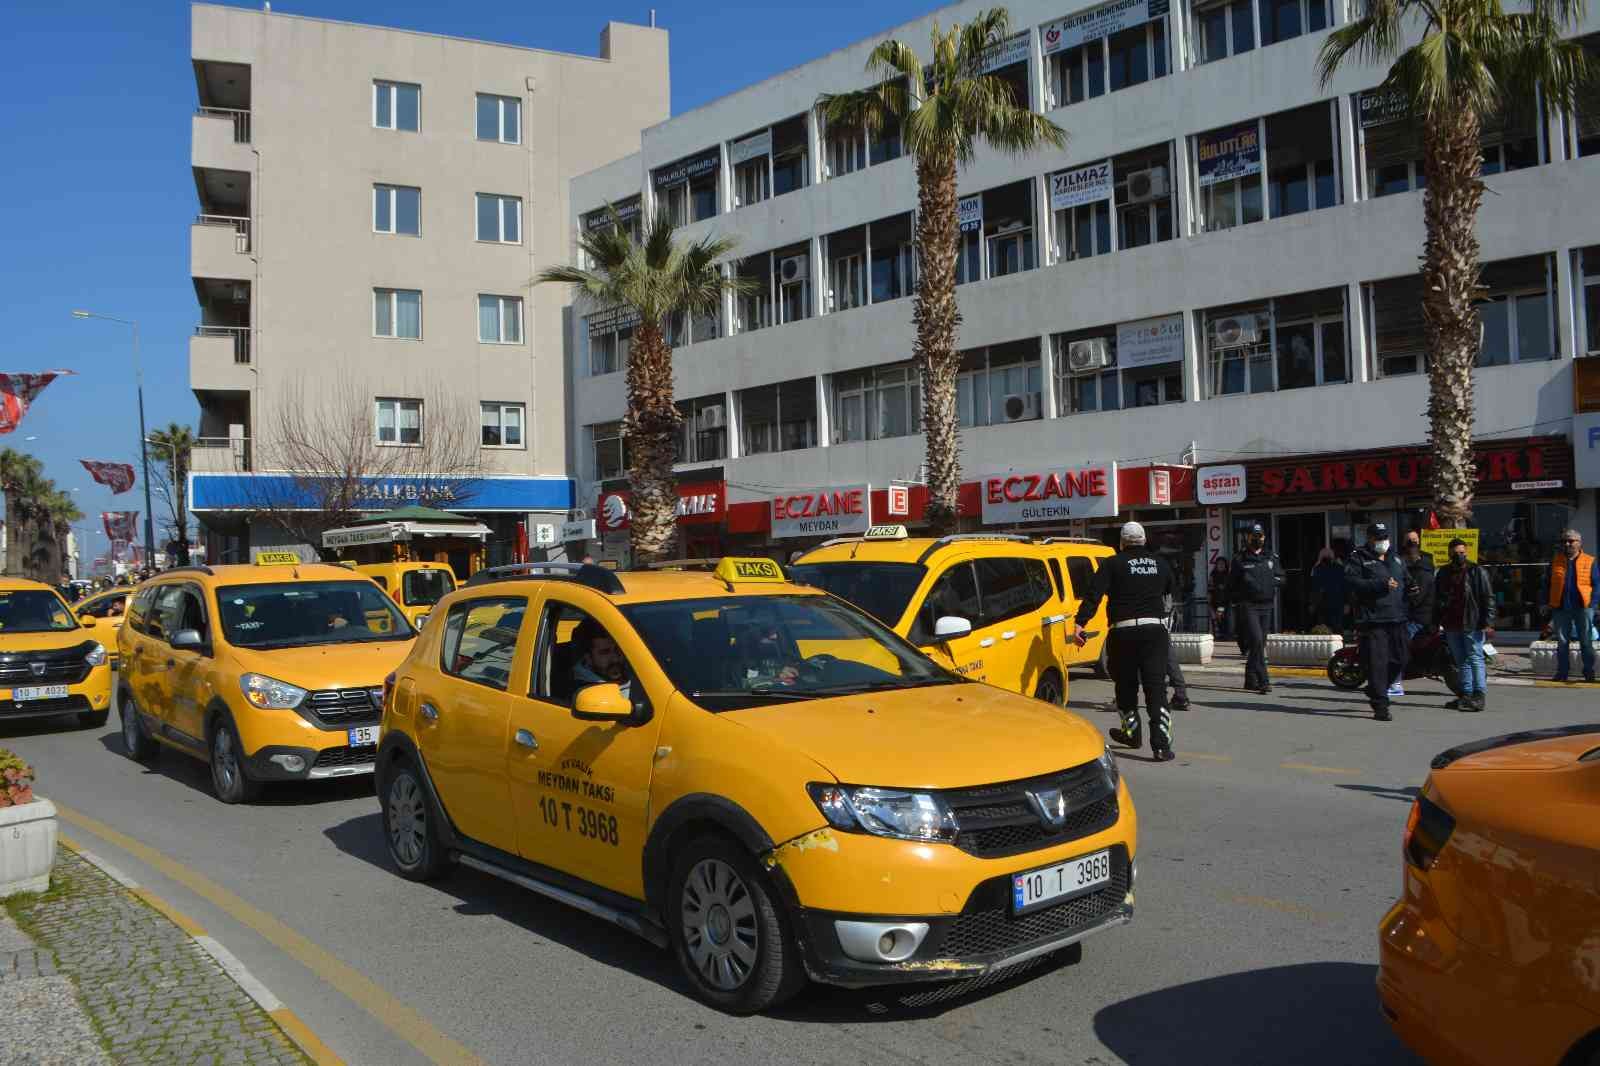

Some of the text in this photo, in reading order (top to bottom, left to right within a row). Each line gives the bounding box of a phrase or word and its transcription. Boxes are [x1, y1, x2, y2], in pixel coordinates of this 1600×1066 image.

[1054, 165, 1109, 189] YILMAZ
[987, 467, 1108, 504] ECZANE
[774, 488, 865, 521] ECZANE
[894, 491, 905, 510] E
[1021, 504, 1071, 519] GÜLTEKİN
[799, 520, 840, 533] MEYDAN
[357, 727, 371, 742] 35
[538, 769, 579, 794] MEYDAN
[538, 796, 618, 847] 10 T 3968
[1026, 873, 1043, 901] 10
[1057, 868, 1064, 892] T
[1077, 855, 1108, 885] 3968
